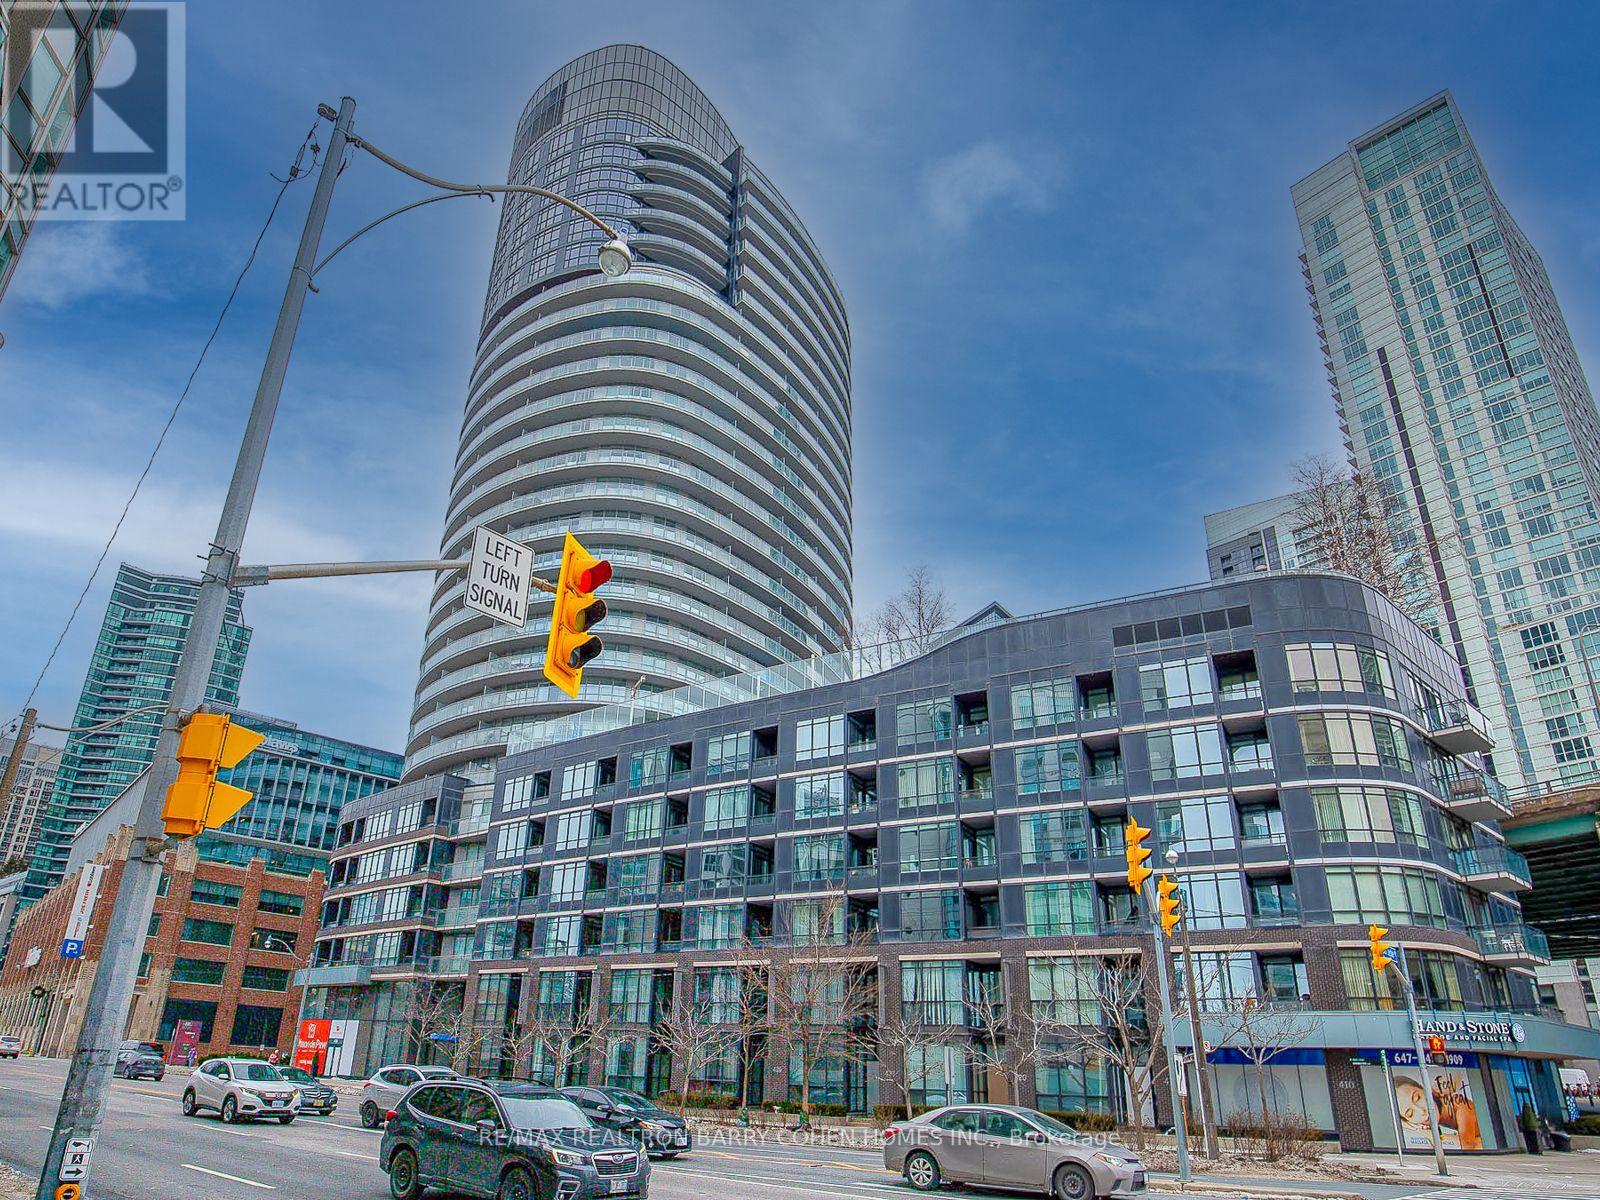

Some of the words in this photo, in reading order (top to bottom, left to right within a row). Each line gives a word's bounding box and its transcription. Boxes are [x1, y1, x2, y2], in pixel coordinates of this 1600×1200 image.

[485, 536, 522, 568] LEFT
[482, 560, 520, 593] TURN
[469, 583, 522, 621] SIGNAL
[1458, 1022, 1466, 1031] &
[1466, 1020, 1510, 1034] STONE
[1338, 1080, 1355, 1089] 410
